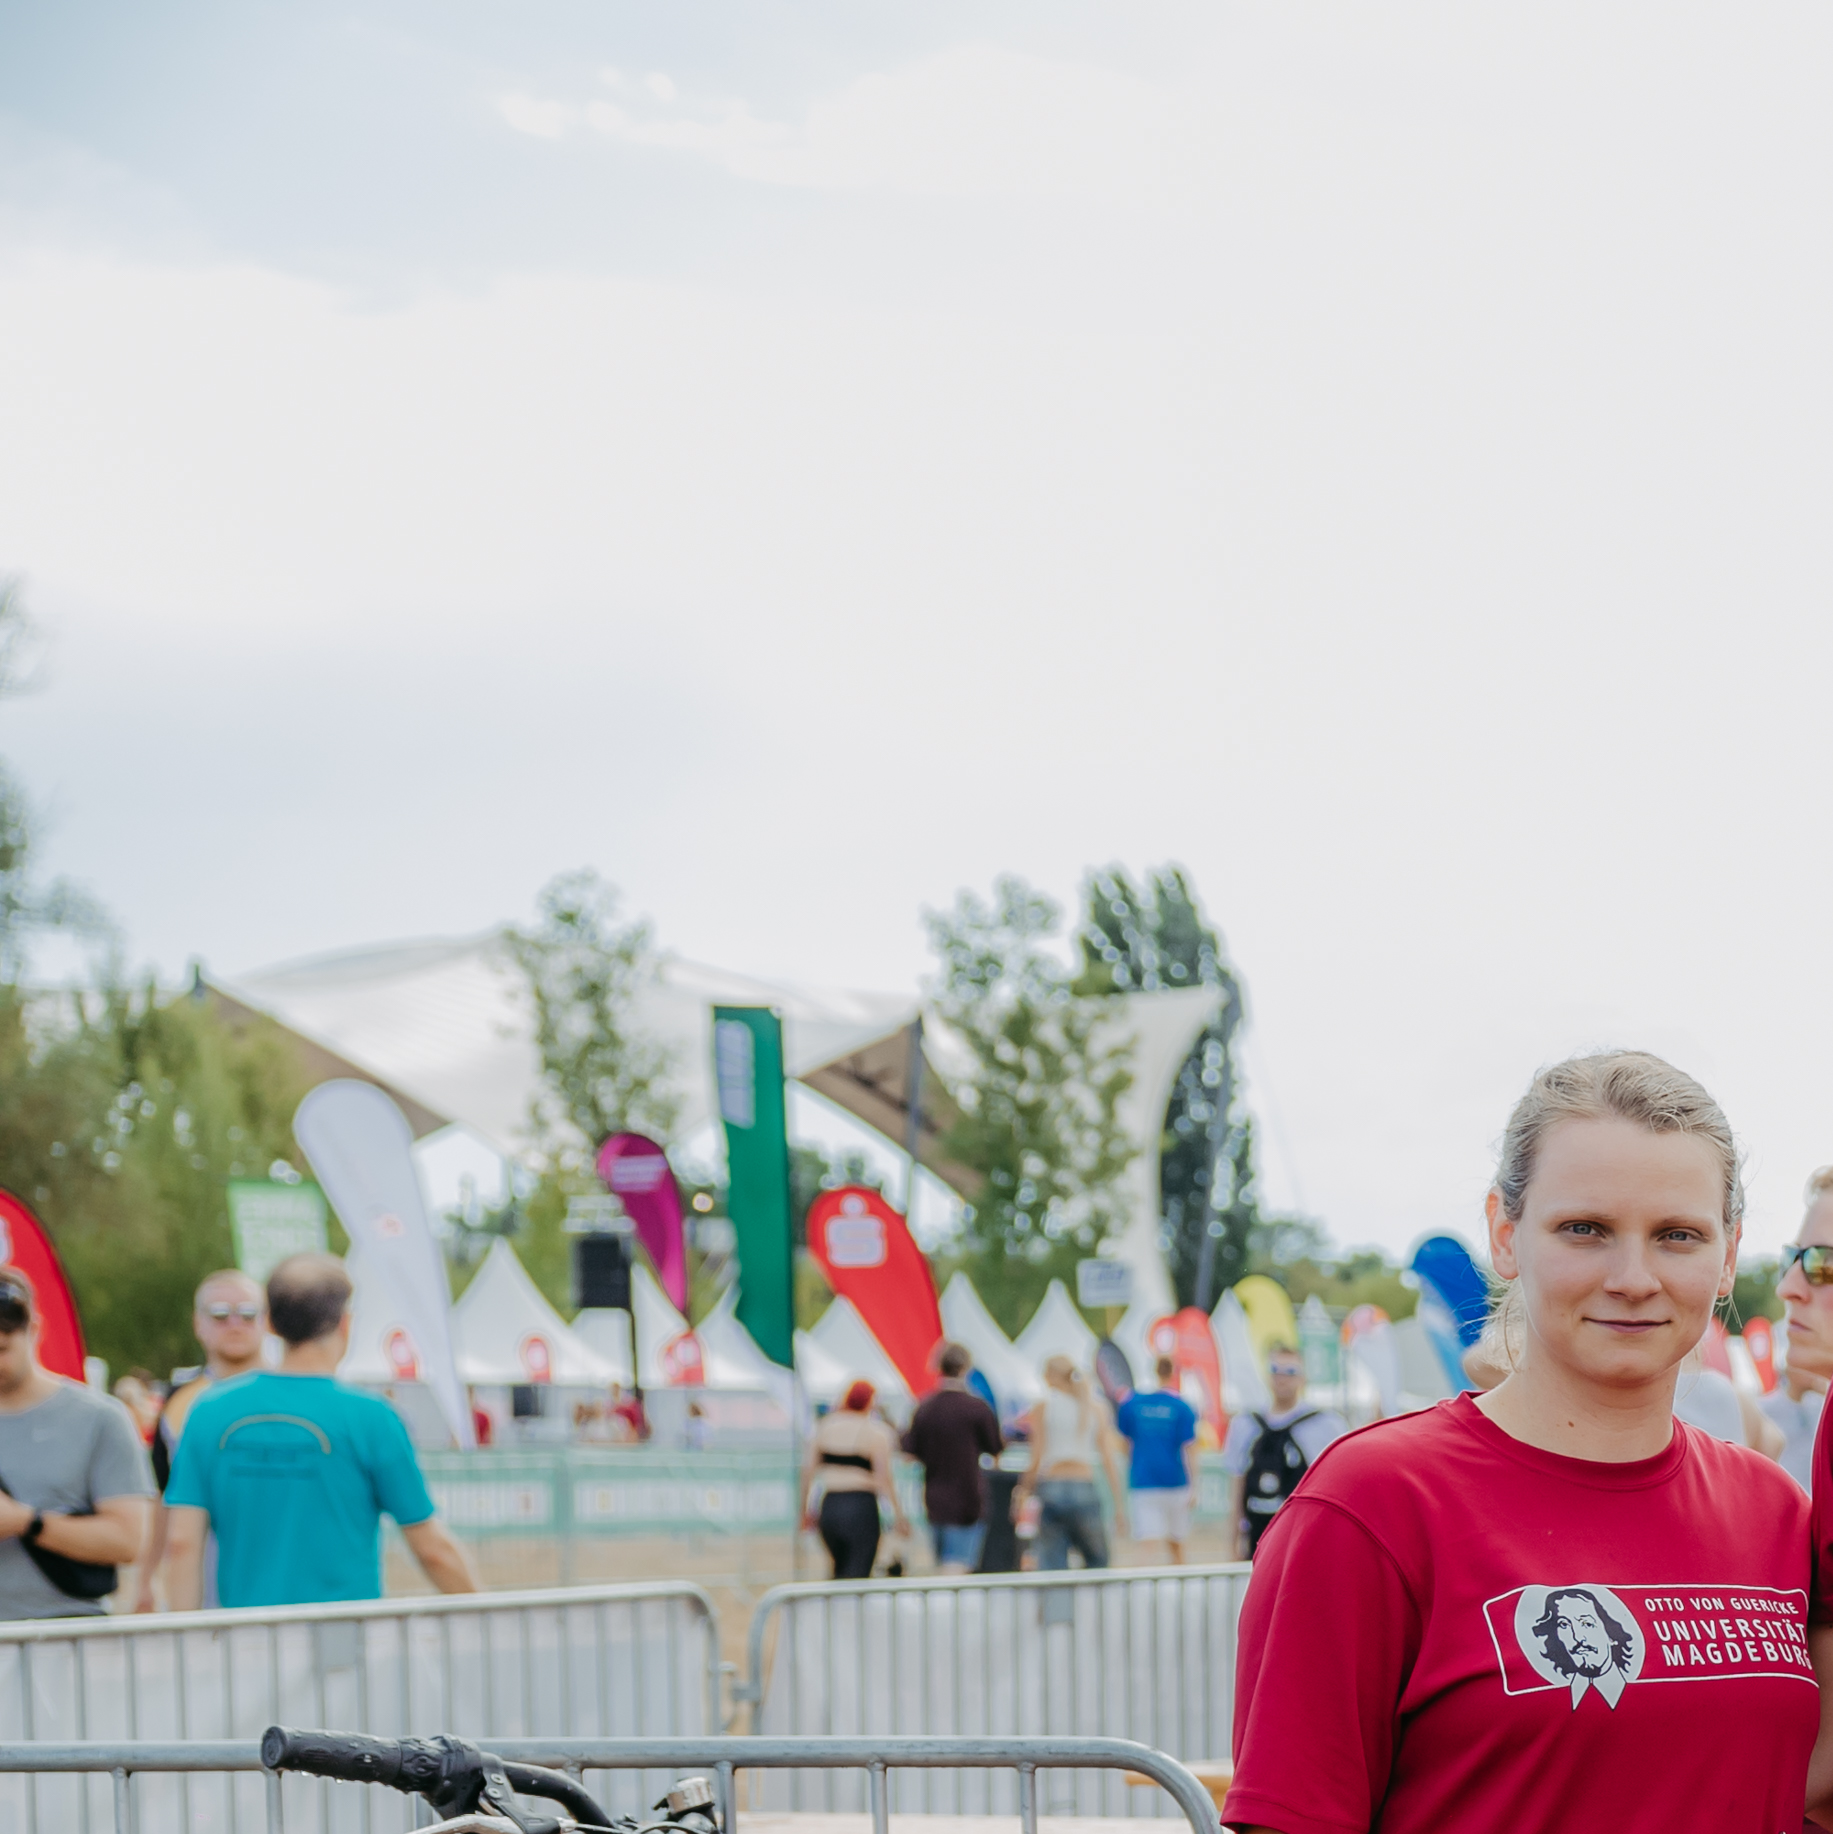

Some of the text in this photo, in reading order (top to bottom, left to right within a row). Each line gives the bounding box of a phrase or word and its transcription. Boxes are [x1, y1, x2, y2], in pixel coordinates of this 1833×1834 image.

[1644, 1597, 1800, 1615] OTTO VON GUERICKE
[1652, 1618, 1806, 1645] UNIVERSITÄT
[1661, 1640, 1813, 1671] MAGDEBURG
